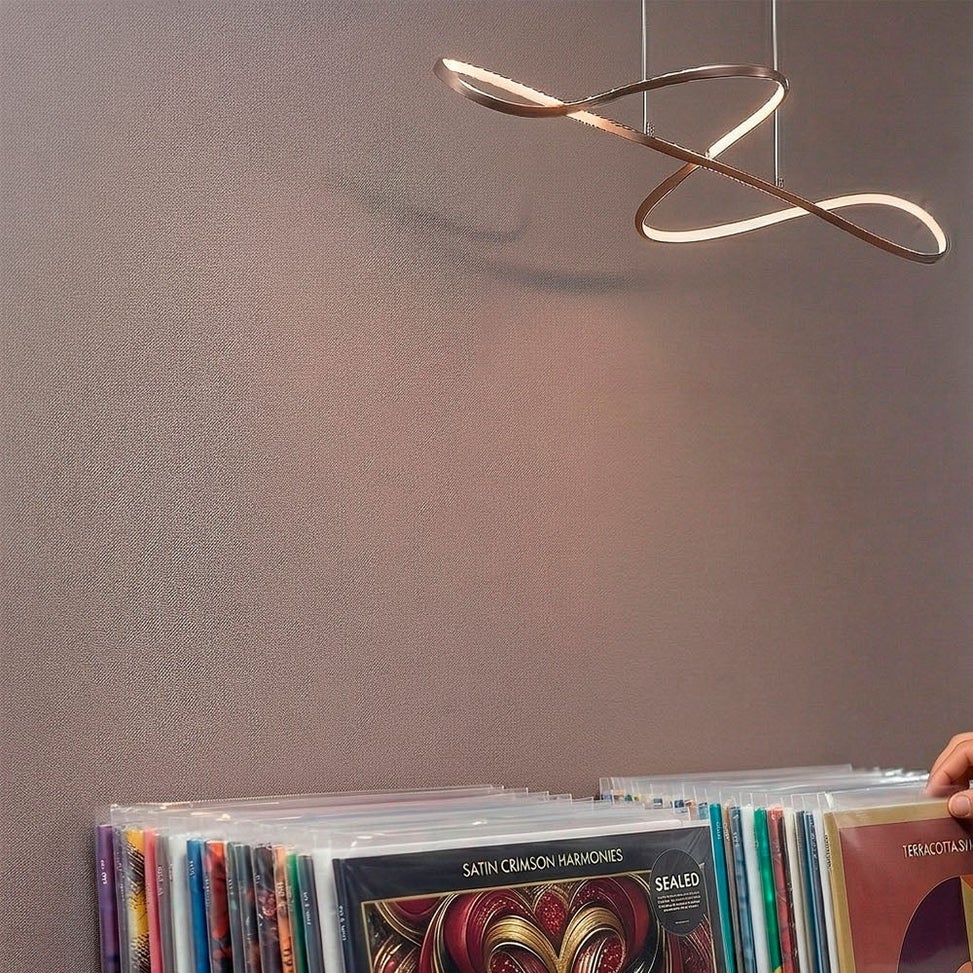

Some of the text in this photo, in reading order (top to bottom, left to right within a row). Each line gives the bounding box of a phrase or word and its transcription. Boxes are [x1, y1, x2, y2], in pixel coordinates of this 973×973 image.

[903, 840, 959, 858] TERRACOTTA
[463, 848, 624, 878] SATIN CRIMSON HARMONIES
[655, 872, 700, 891] SEALED
